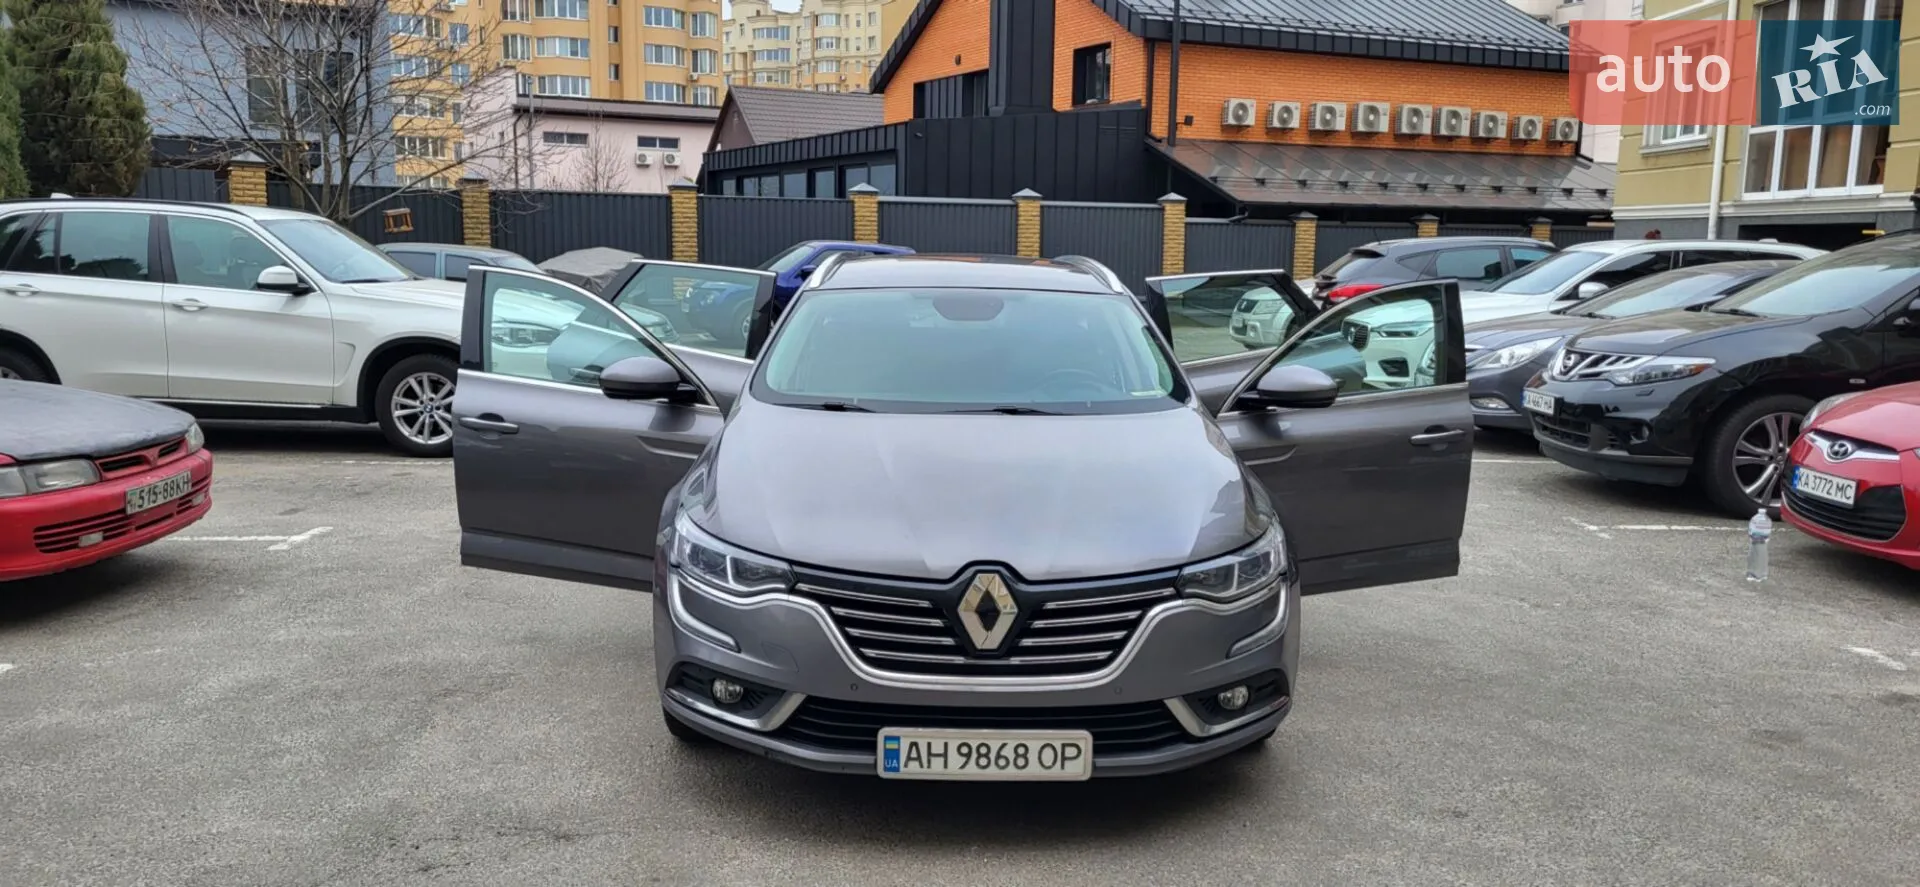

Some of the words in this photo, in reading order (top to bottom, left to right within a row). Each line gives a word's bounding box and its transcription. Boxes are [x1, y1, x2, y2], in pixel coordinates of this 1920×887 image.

[1798, 470, 1809, 488] KA
[1811, 475, 1833, 496] 3772
[1835, 483, 1852, 500] MC
[884, 759, 899, 768] UA
[903, 741, 949, 769] AH
[956, 742, 1029, 770] 9868
[1037, 743, 1082, 770] OP
